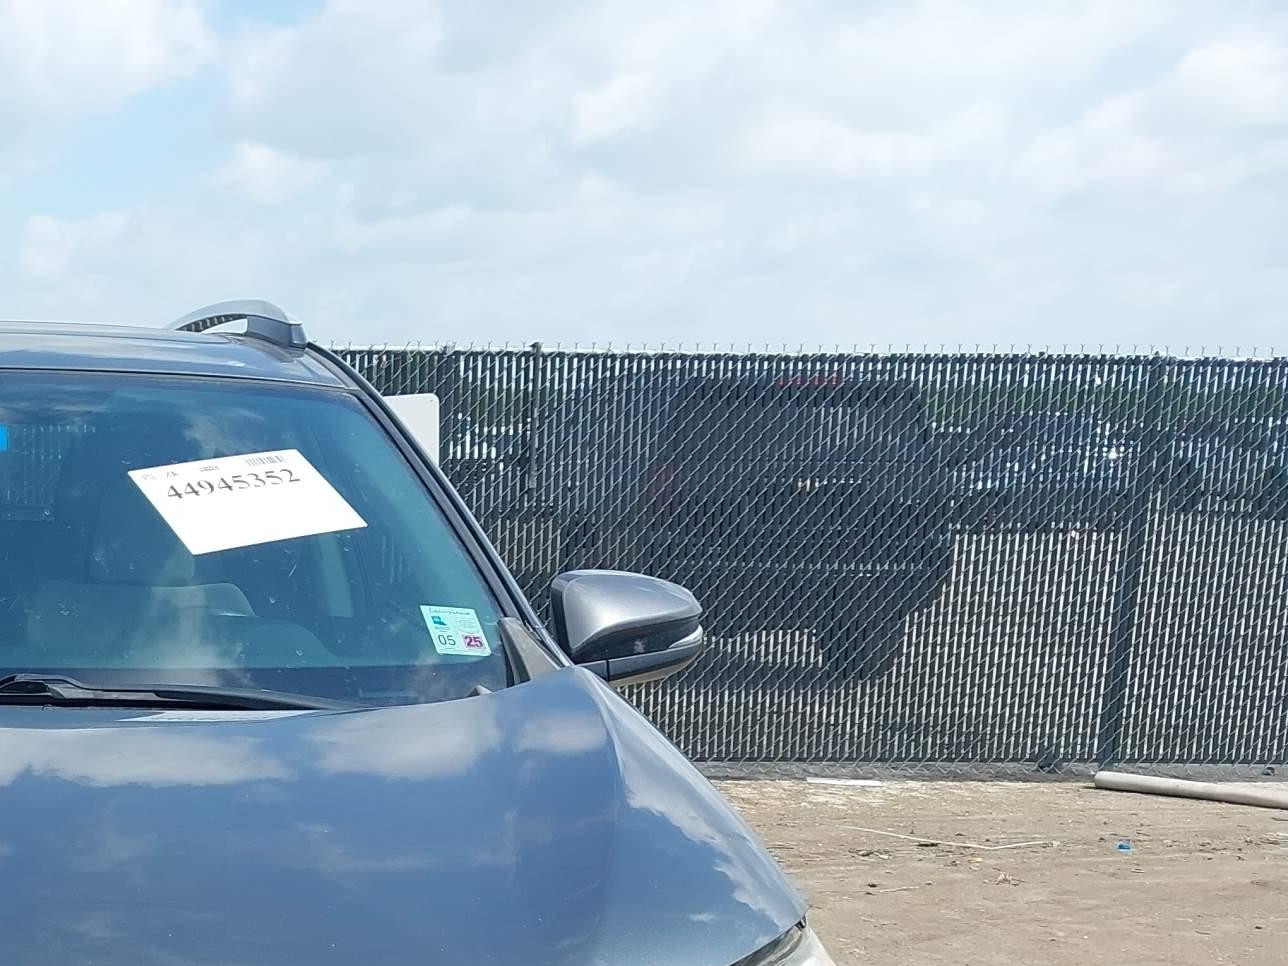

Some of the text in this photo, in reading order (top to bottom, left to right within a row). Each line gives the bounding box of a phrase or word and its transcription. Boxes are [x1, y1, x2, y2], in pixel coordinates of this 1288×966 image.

[167, 468, 301, 500] 44945352
[437, 634, 457, 647] 05
[463, 635, 484, 648] 25
